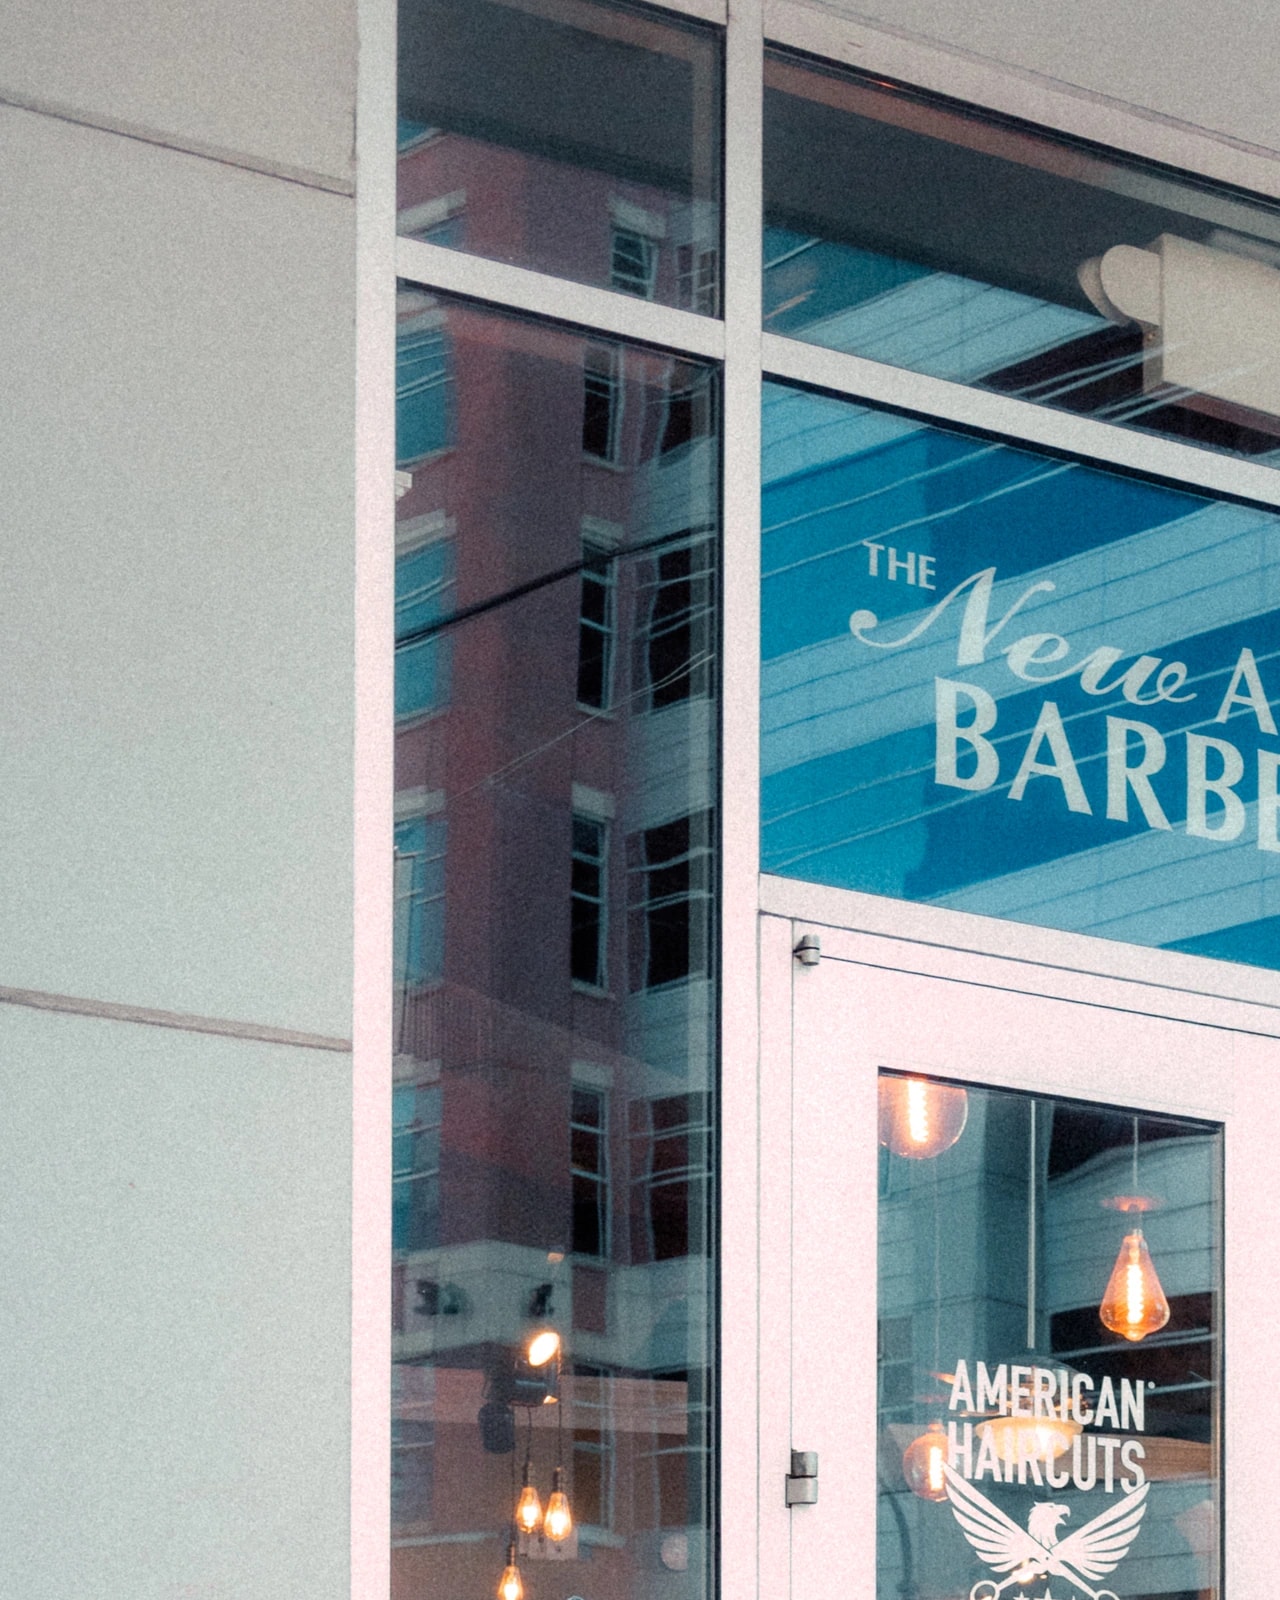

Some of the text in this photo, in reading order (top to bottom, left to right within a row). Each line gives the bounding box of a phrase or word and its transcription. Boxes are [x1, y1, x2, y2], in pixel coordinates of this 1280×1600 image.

[863, 541, 937, 590] THE
[850, 566, 1197, 707] New
[949, 1359, 1145, 1432] AMERICAN
[948, 1421, 1146, 1495] HAIRCUTS
